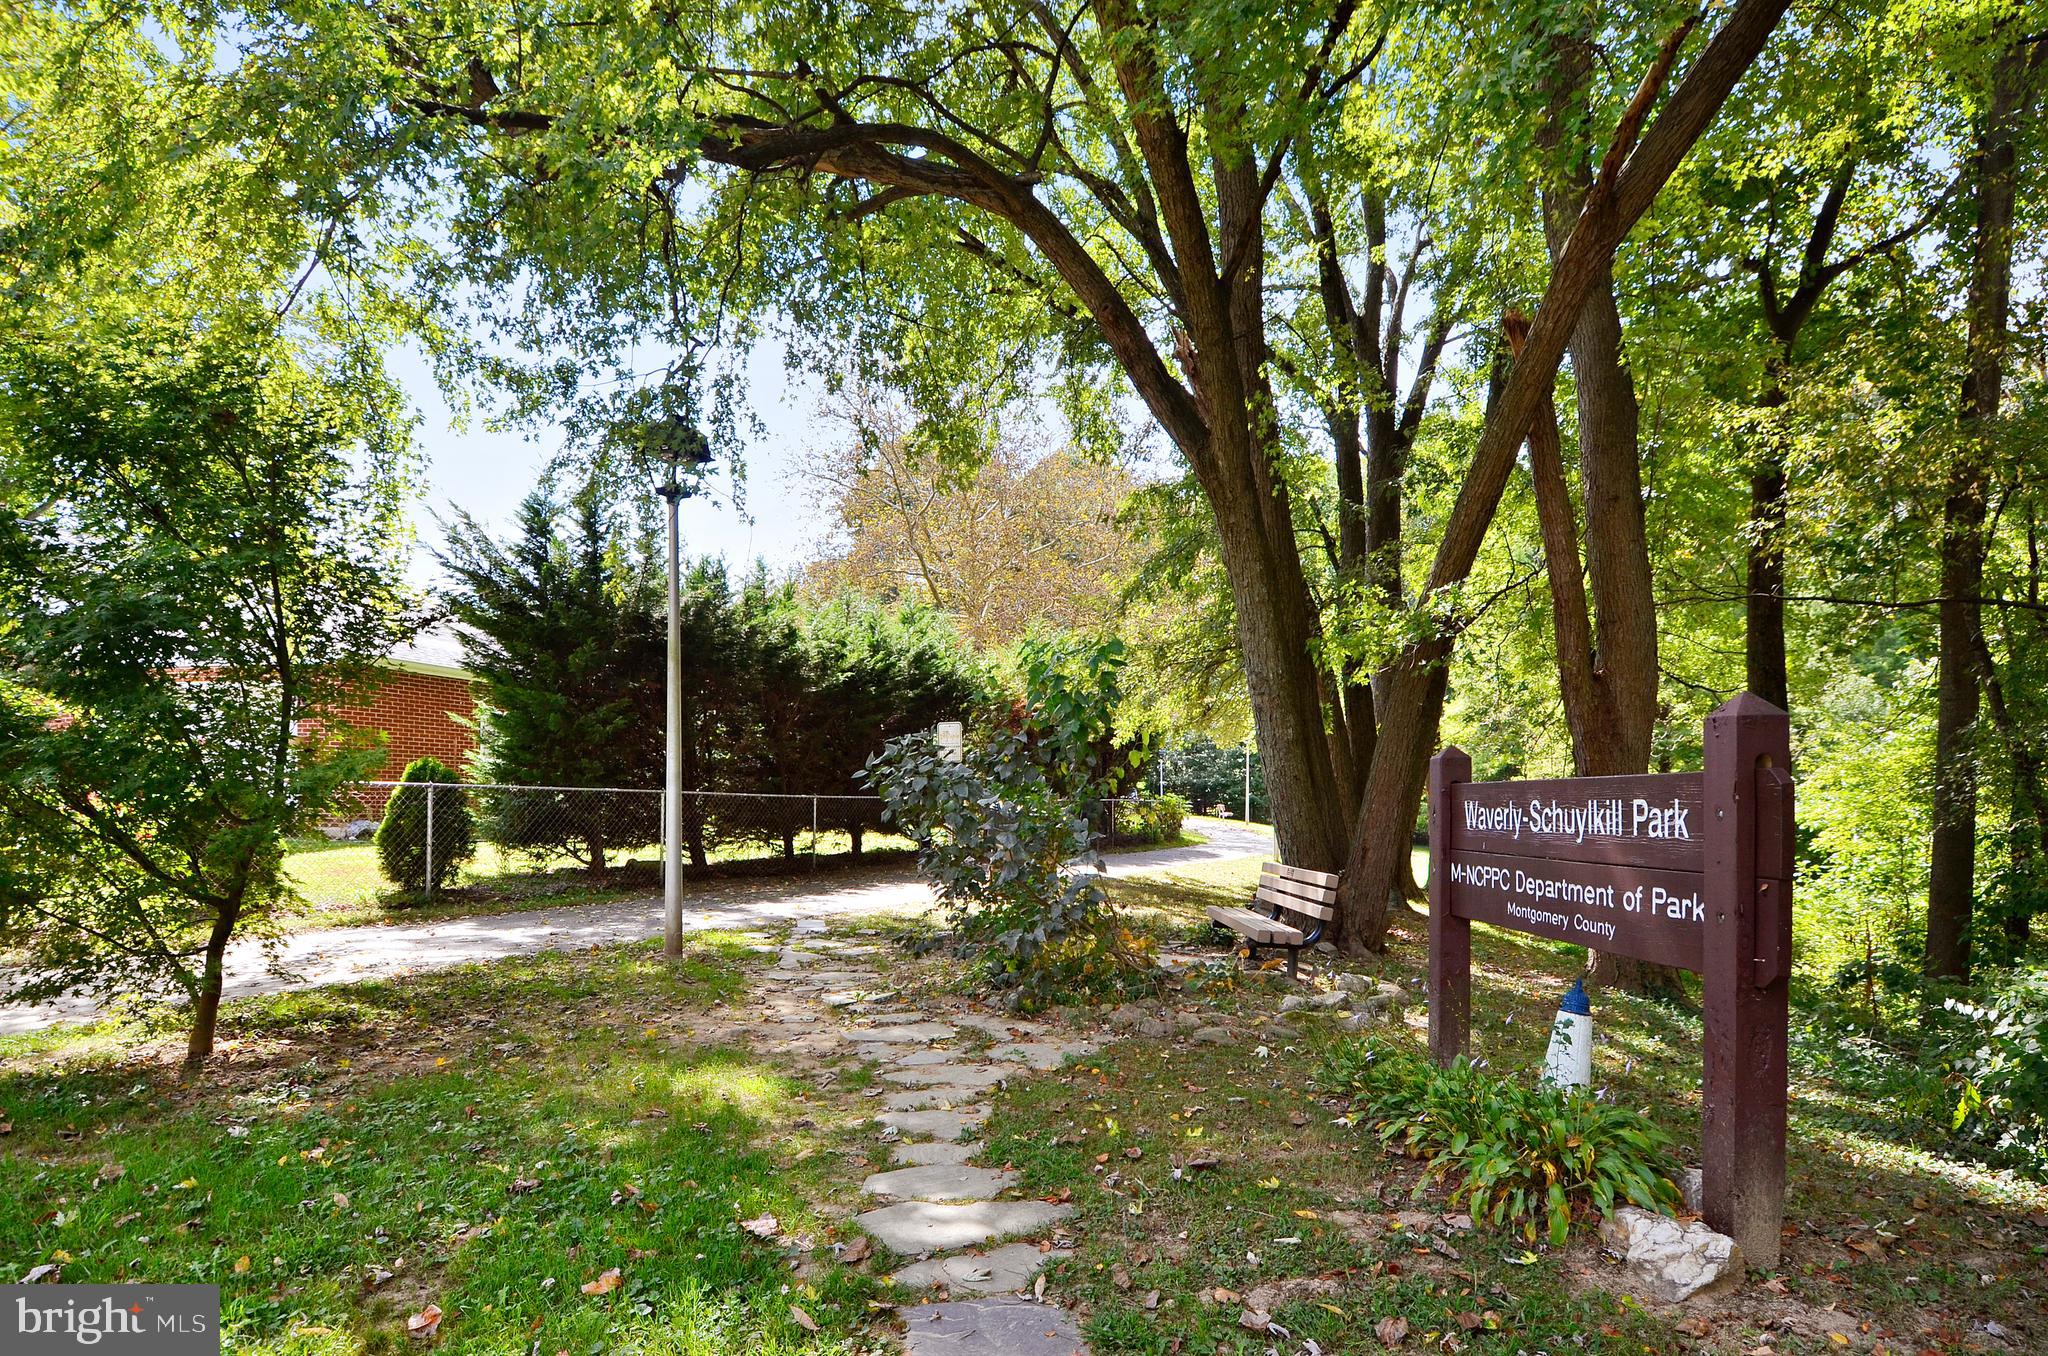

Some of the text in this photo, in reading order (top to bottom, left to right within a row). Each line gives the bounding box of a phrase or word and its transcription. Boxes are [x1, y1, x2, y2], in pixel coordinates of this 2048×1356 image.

[1464, 798, 1690, 843] Waverly-Schuylkill Park
[1450, 862, 1511, 891] M-NCPPC
[1515, 871, 1615, 909] Department
[1623, 886, 1644, 913] of
[1507, 901, 1616, 941] Montgomery County
